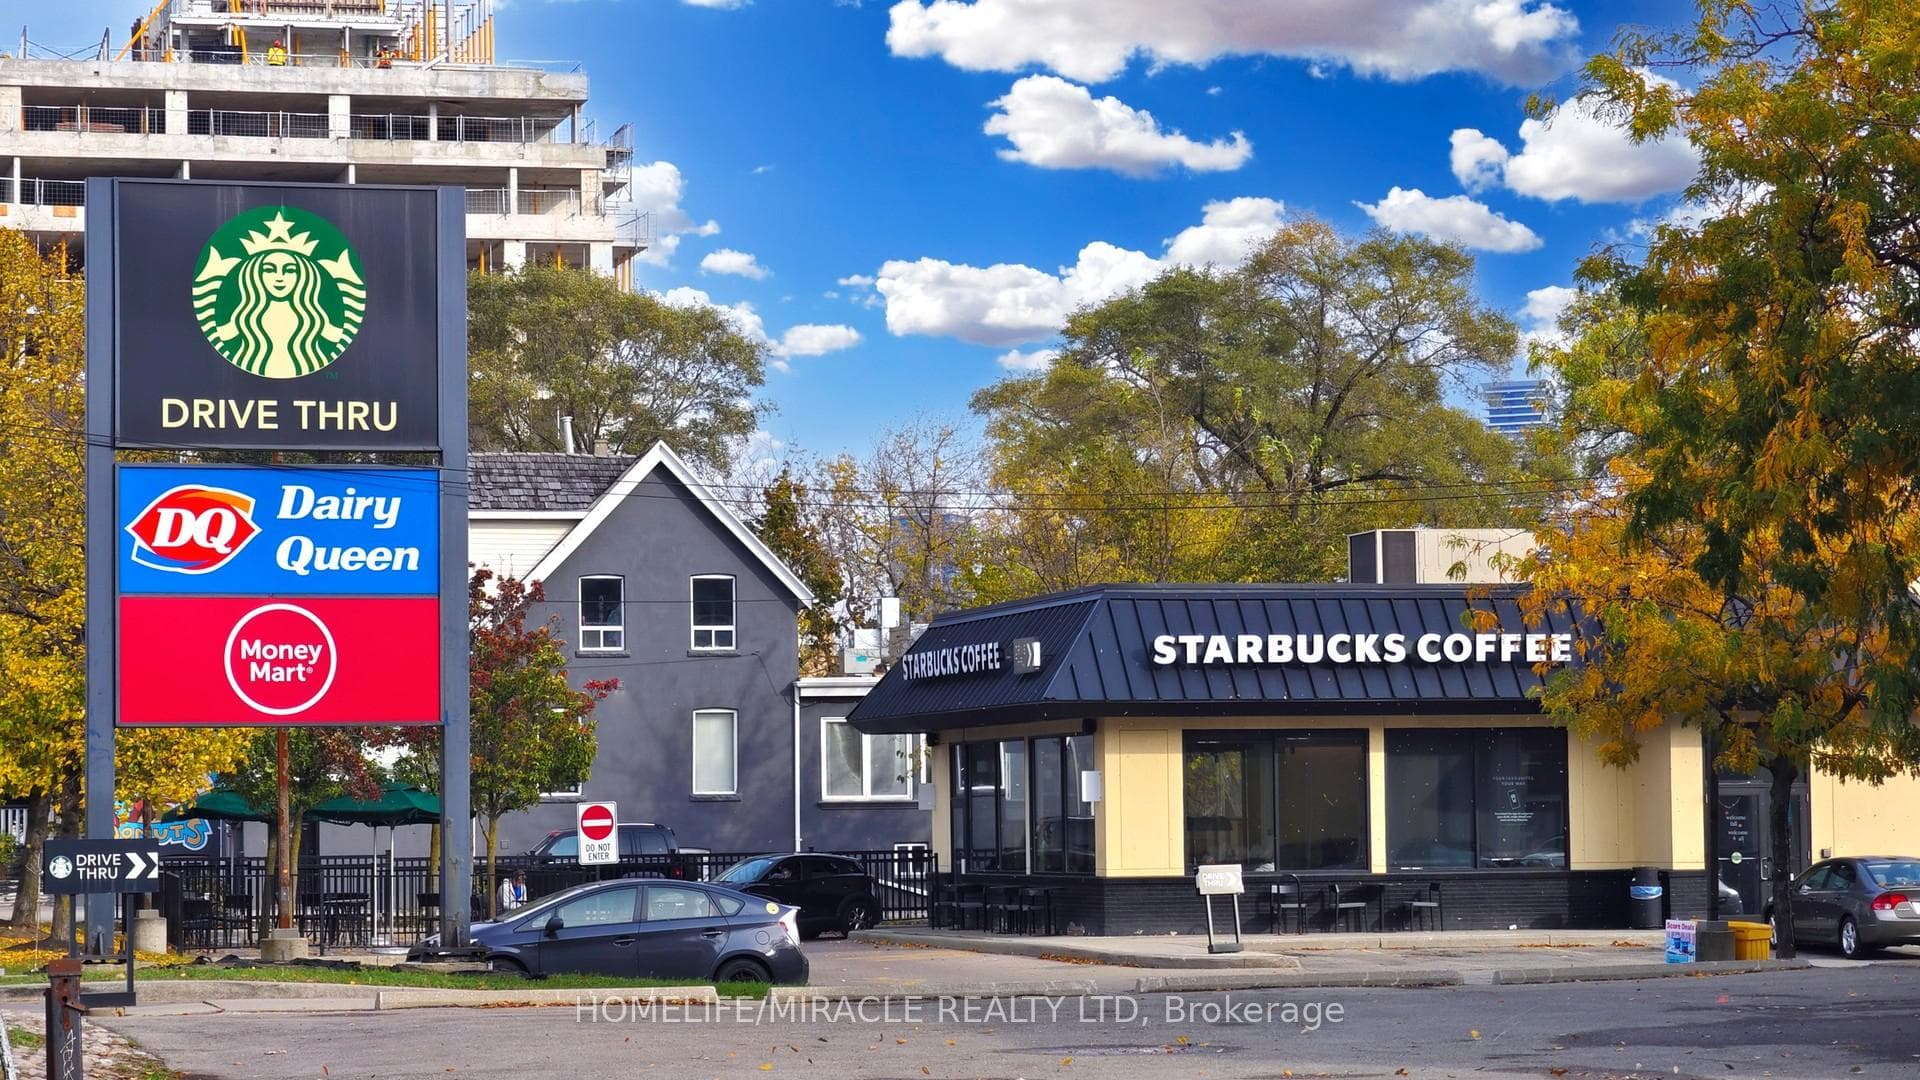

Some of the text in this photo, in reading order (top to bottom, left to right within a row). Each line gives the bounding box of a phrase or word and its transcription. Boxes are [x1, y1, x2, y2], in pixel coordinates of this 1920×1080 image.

[162, 398, 398, 432] DRIVE THRU
[276, 485, 401, 529] Dairy
[151, 507, 238, 554] DQ
[276, 535, 420, 576] Queen
[240, 639, 323, 665] Money
[902, 646, 959, 681] STARBUCKS
[961, 641, 1001, 673] COFFEE
[1153, 631, 1573, 665] STARBUCKS COFFEE
[76, 854, 121, 866] DRIVE
[585, 843, 611, 852] DO NOT
[588, 852, 610, 861] ENTER
[76, 867, 118, 880] THRU
